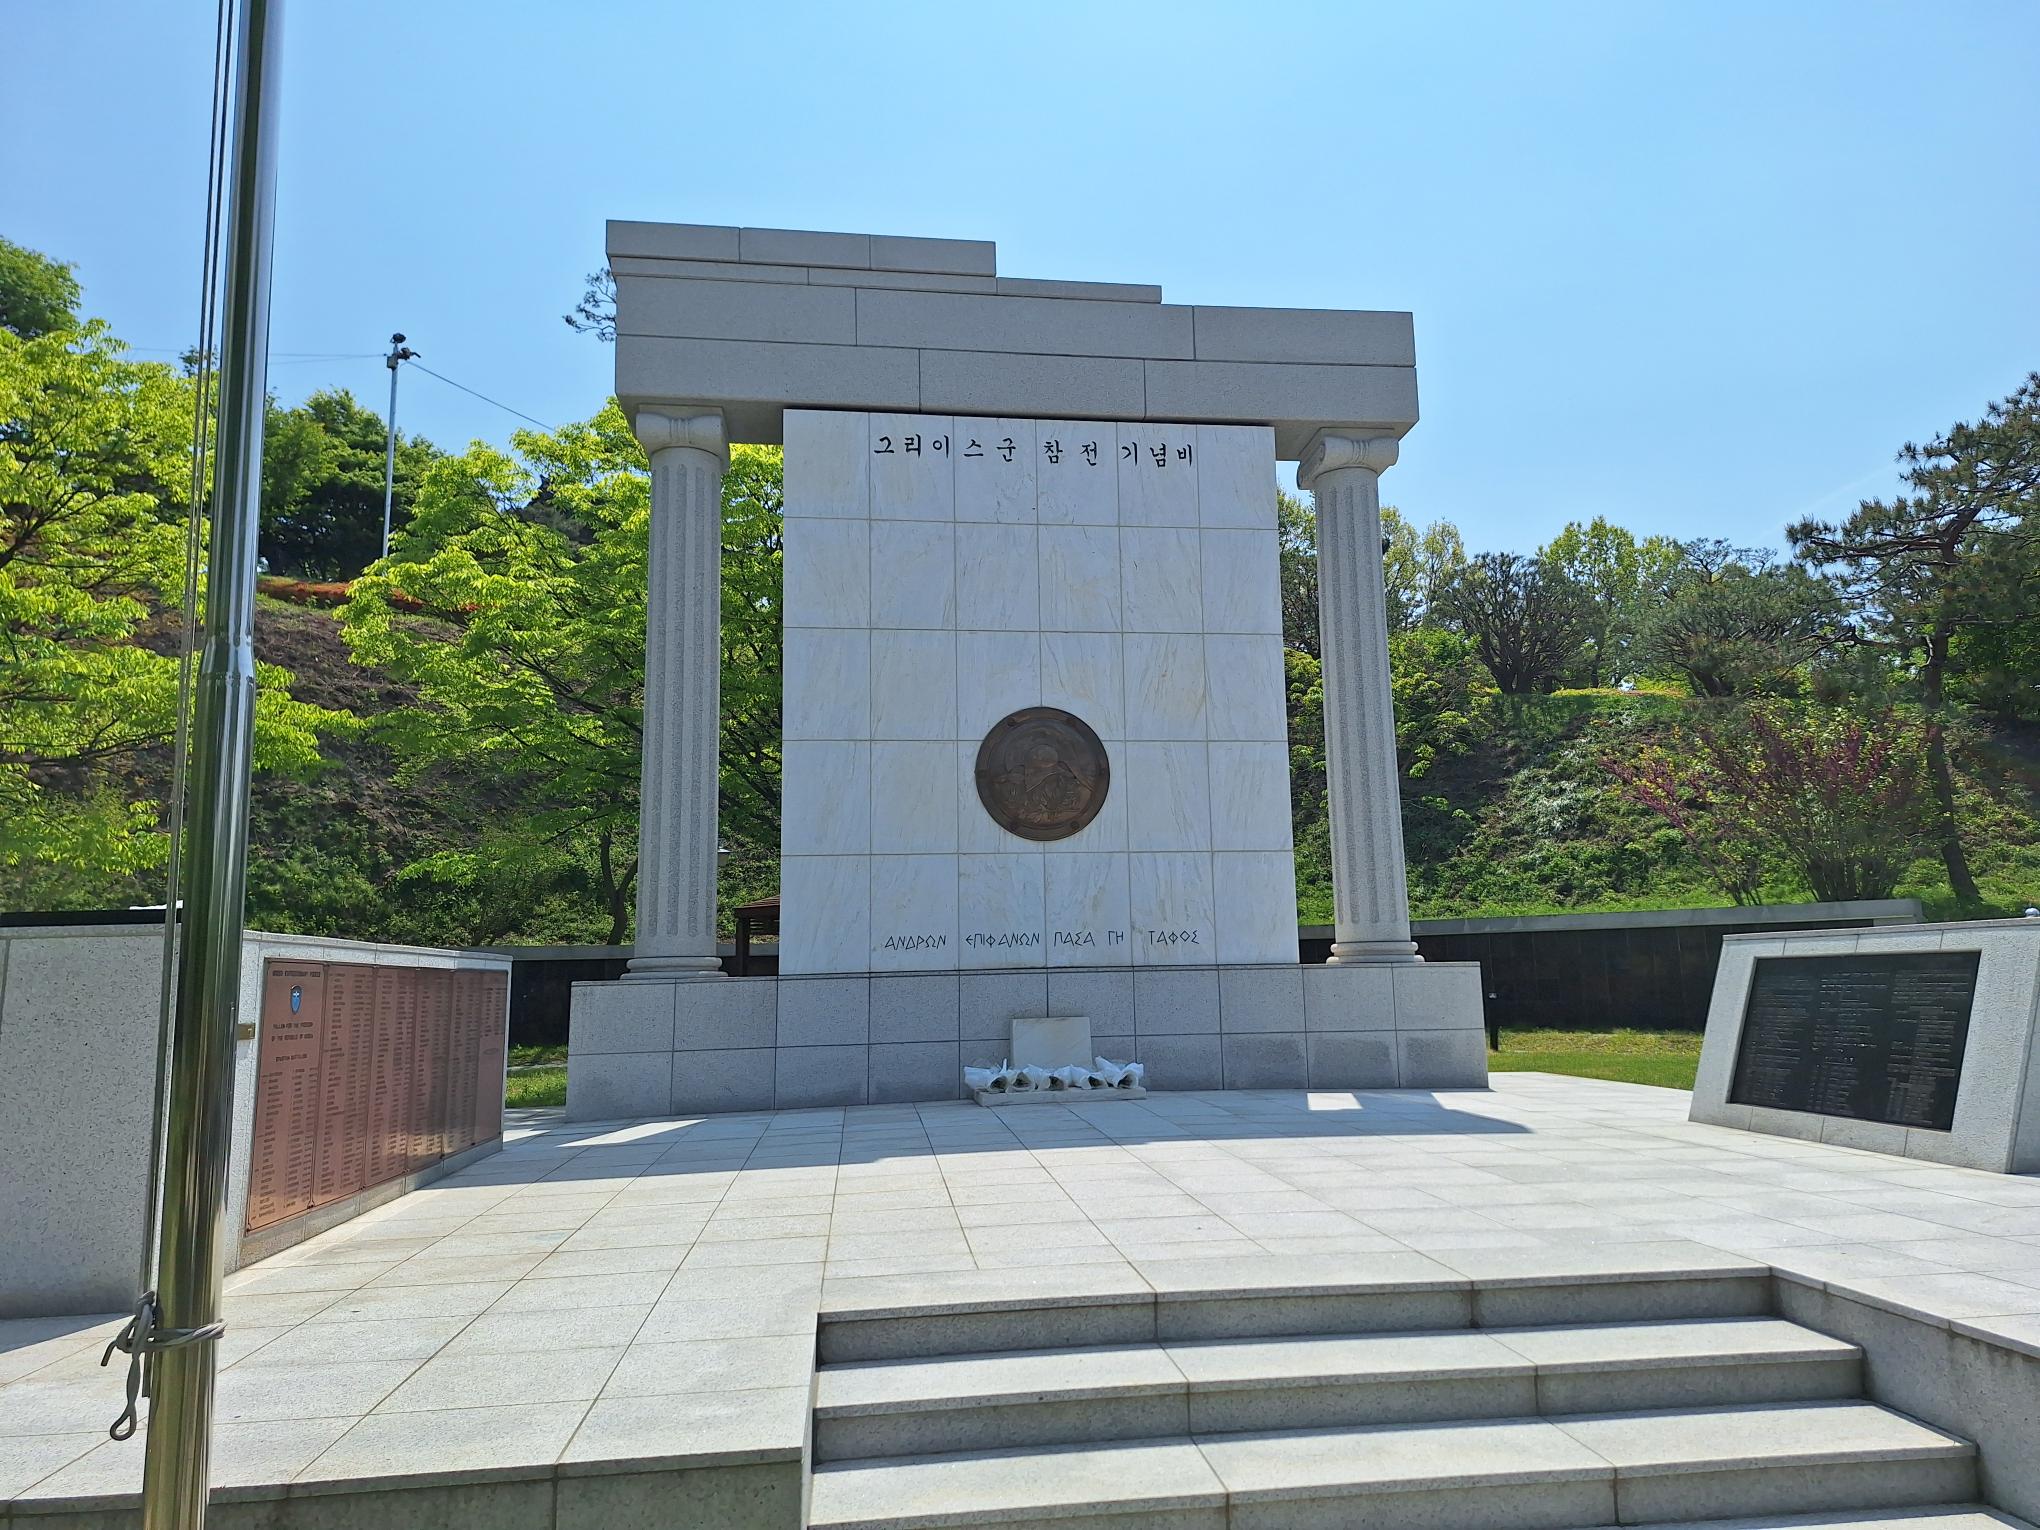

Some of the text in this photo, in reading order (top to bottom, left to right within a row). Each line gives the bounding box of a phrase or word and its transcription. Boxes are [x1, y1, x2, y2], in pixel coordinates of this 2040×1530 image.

[874, 433, 1193, 468] 그리이스군 참전 기념비
[884, 934, 947, 950] ΑΝΔΡΩΝ
[1053, 930, 1096, 947] ΠΑΣΑ
[1107, 930, 1124, 946] ΓΗ
[1148, 929, 1200, 946] ΤΑΦΟΣ
